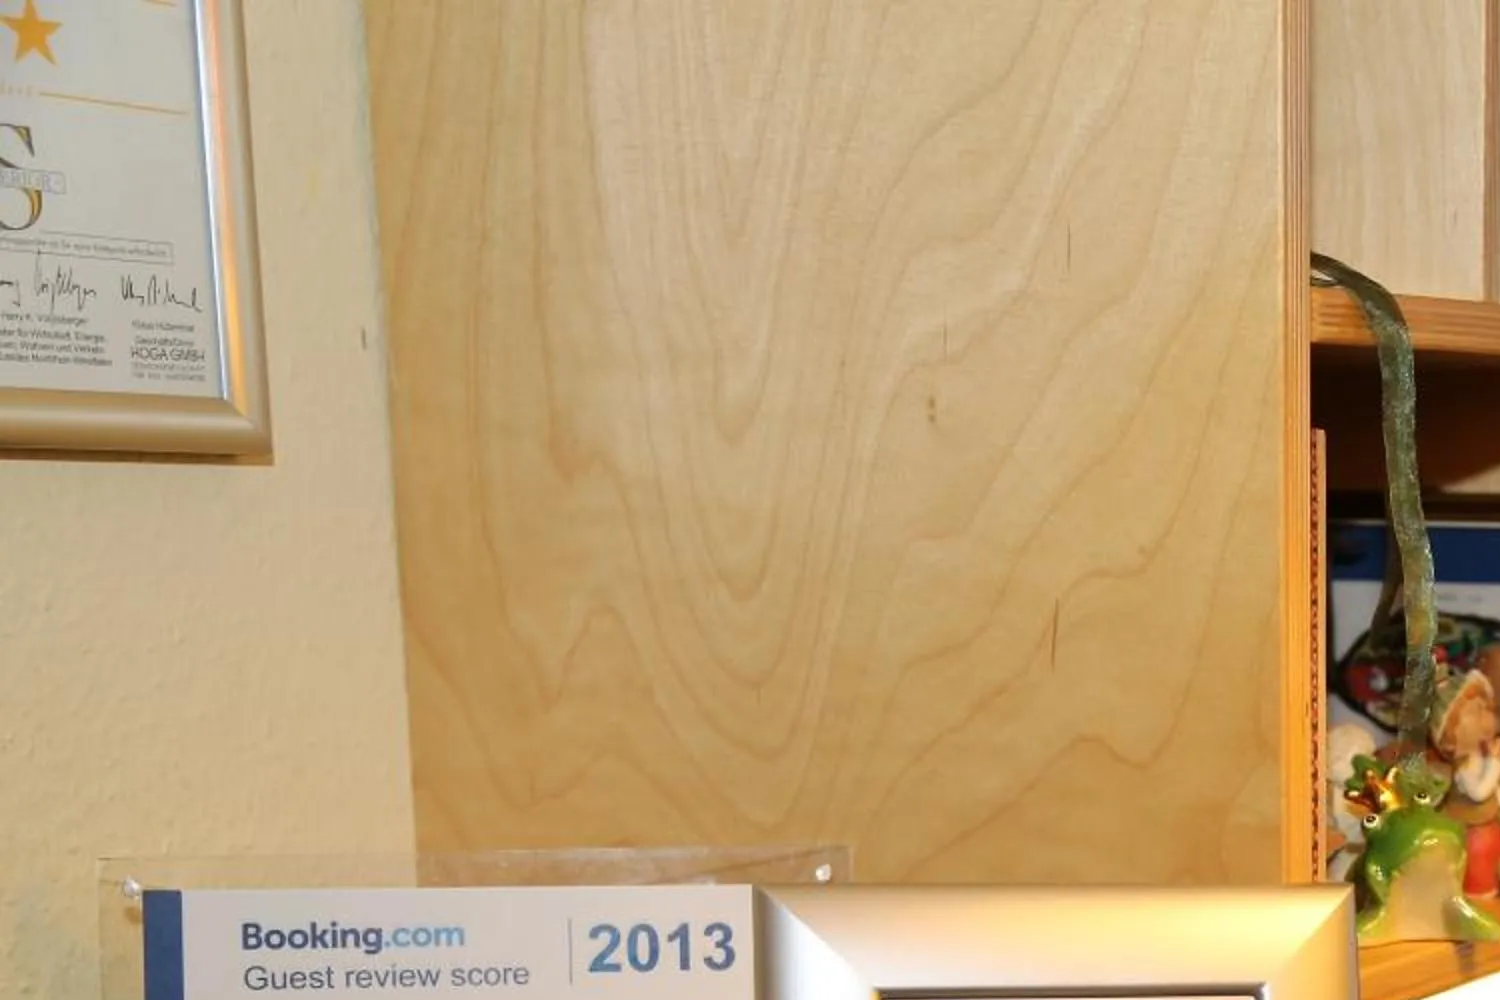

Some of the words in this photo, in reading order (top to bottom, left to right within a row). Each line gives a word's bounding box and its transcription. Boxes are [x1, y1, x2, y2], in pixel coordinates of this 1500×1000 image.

[240, 922, 466, 955] Booking.com
[587, 922, 737, 973] 2013
[243, 965, 335, 991] Guest
[344, 963, 441, 989] review
[450, 963, 530, 987] score
